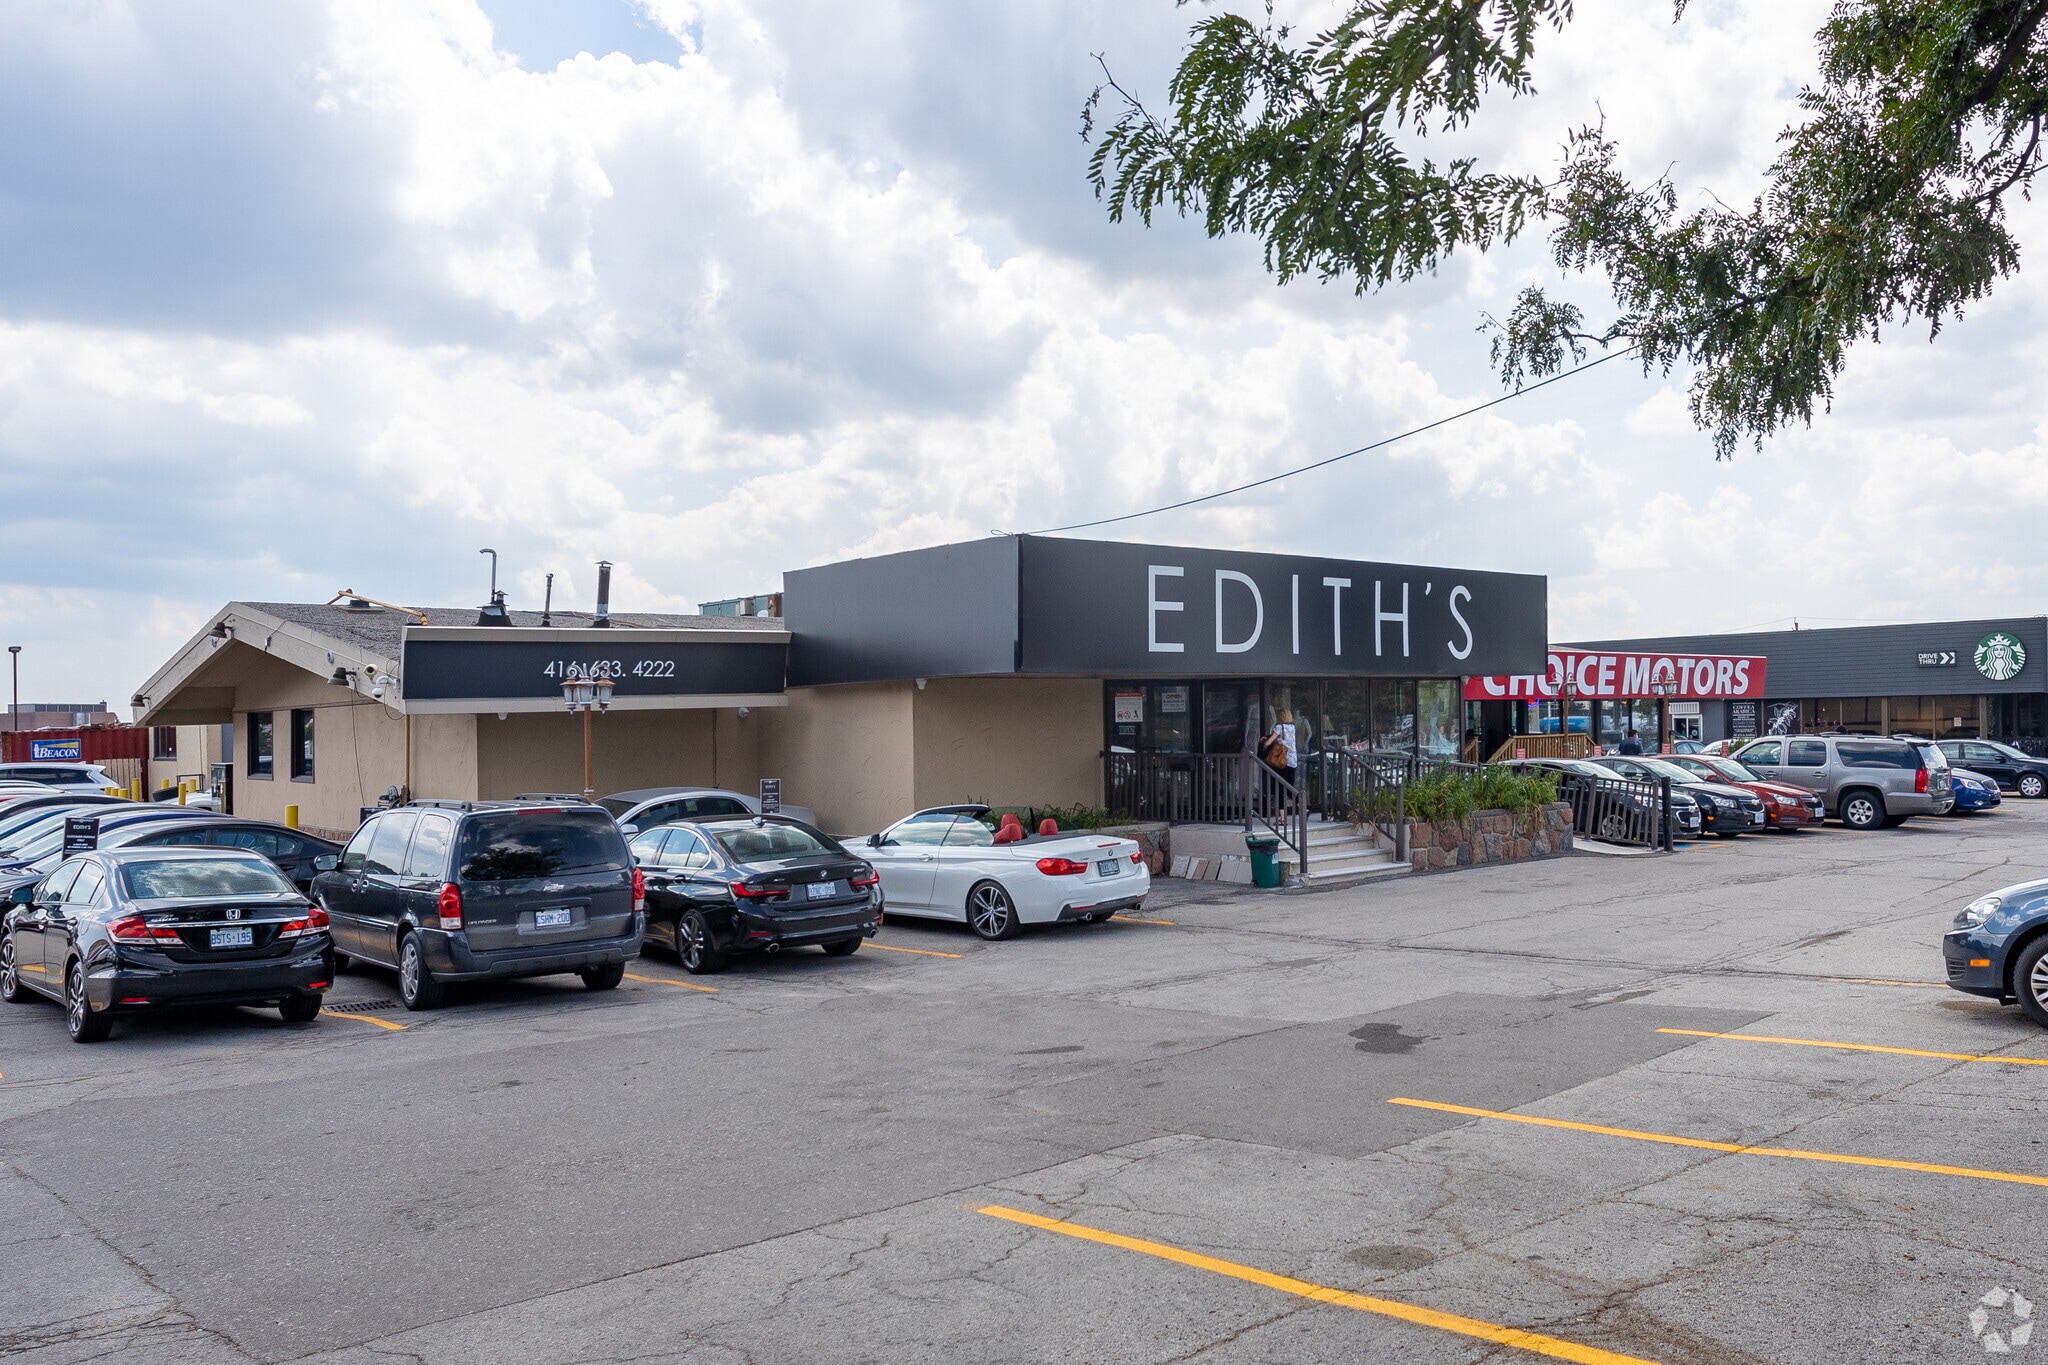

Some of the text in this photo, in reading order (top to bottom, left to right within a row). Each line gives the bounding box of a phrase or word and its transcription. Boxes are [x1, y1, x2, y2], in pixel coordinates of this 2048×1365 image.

[1147, 564, 1474, 660] EDITH'S
[632, 660, 675, 677] 4222
[1622, 657, 1750, 695] MOTORS
[40, 747, 79, 758] BEACON
